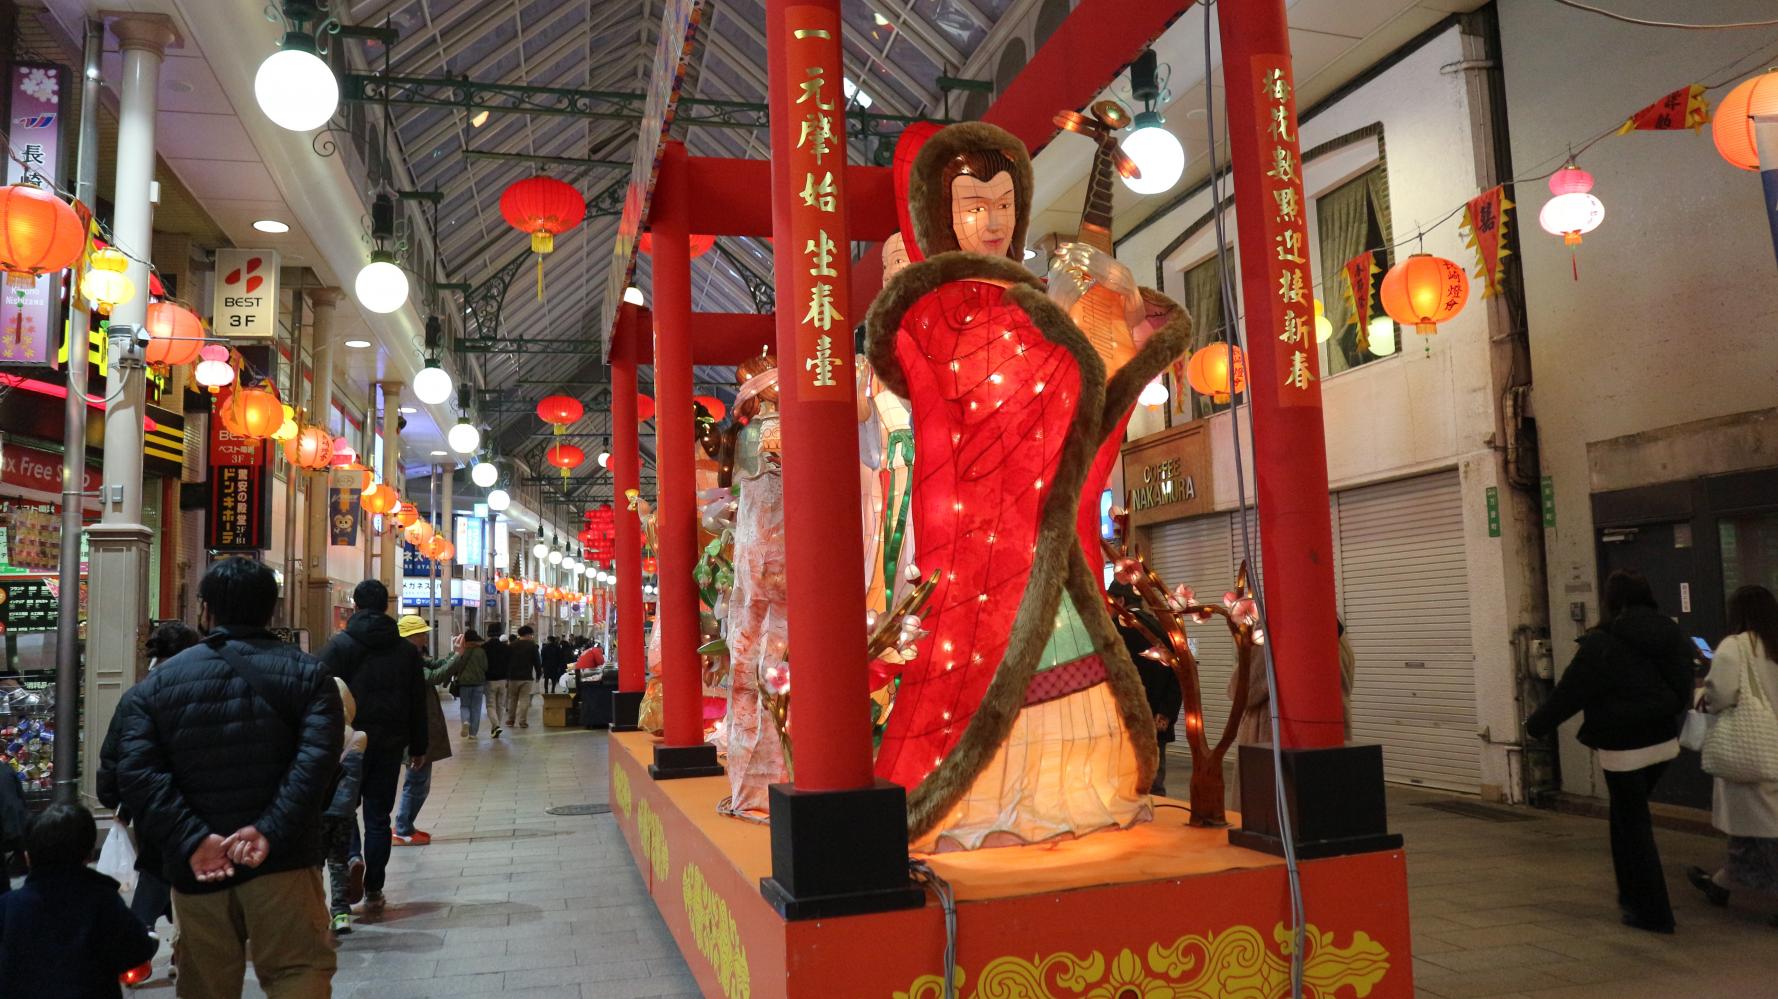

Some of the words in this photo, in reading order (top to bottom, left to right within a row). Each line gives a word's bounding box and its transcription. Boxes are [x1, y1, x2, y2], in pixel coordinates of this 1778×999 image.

[224, 297, 263, 308] BEST
[230, 314, 256, 327] 3F
[20, 456, 53, 481] Free
[1143, 457, 1181, 483] COFFEE
[1132, 475, 1195, 511] NAKAMURA
